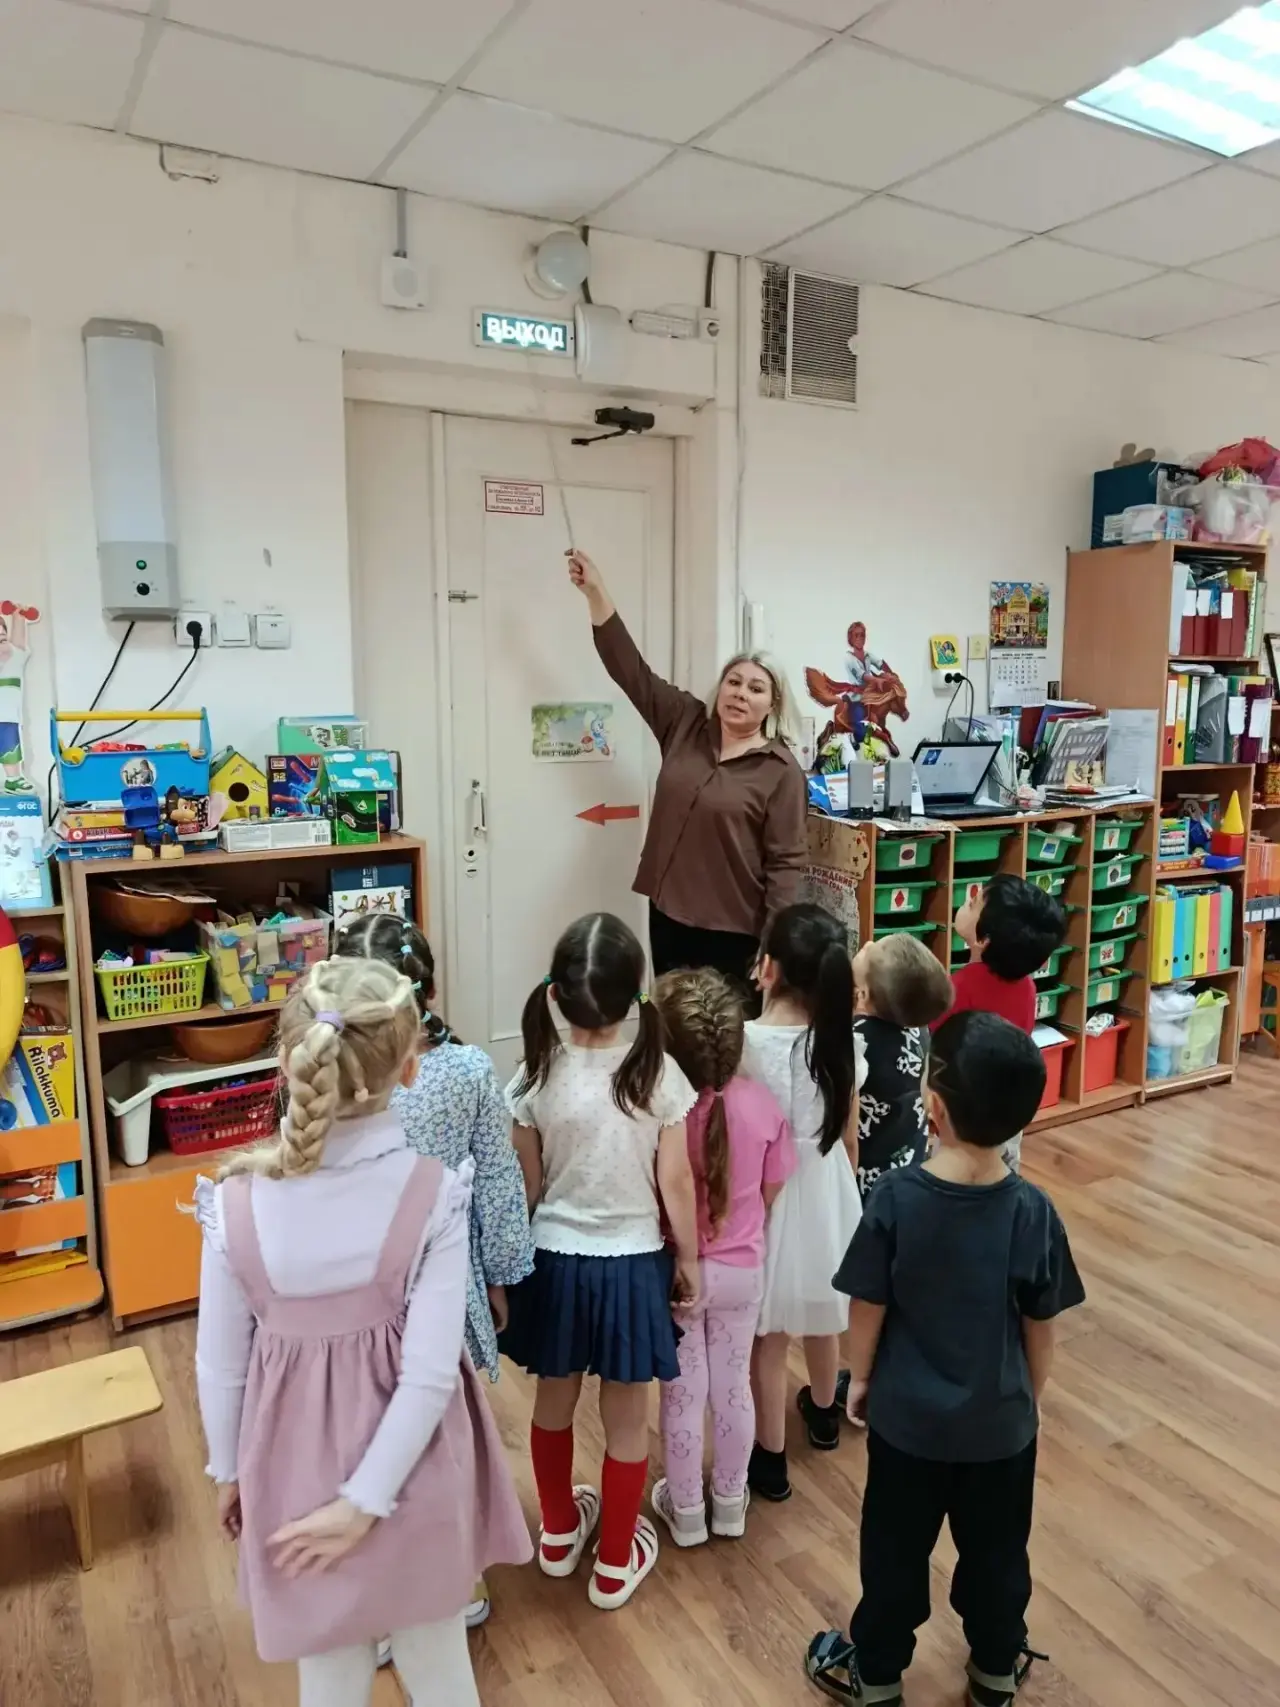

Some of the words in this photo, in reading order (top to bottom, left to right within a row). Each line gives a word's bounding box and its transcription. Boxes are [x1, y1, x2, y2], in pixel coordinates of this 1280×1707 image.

[486, 317, 565, 350] ВЫХОД
[812, 866, 853, 888] РОЖДЕНИЯ
[28, 1046, 61, 1118] Rilakkuma
